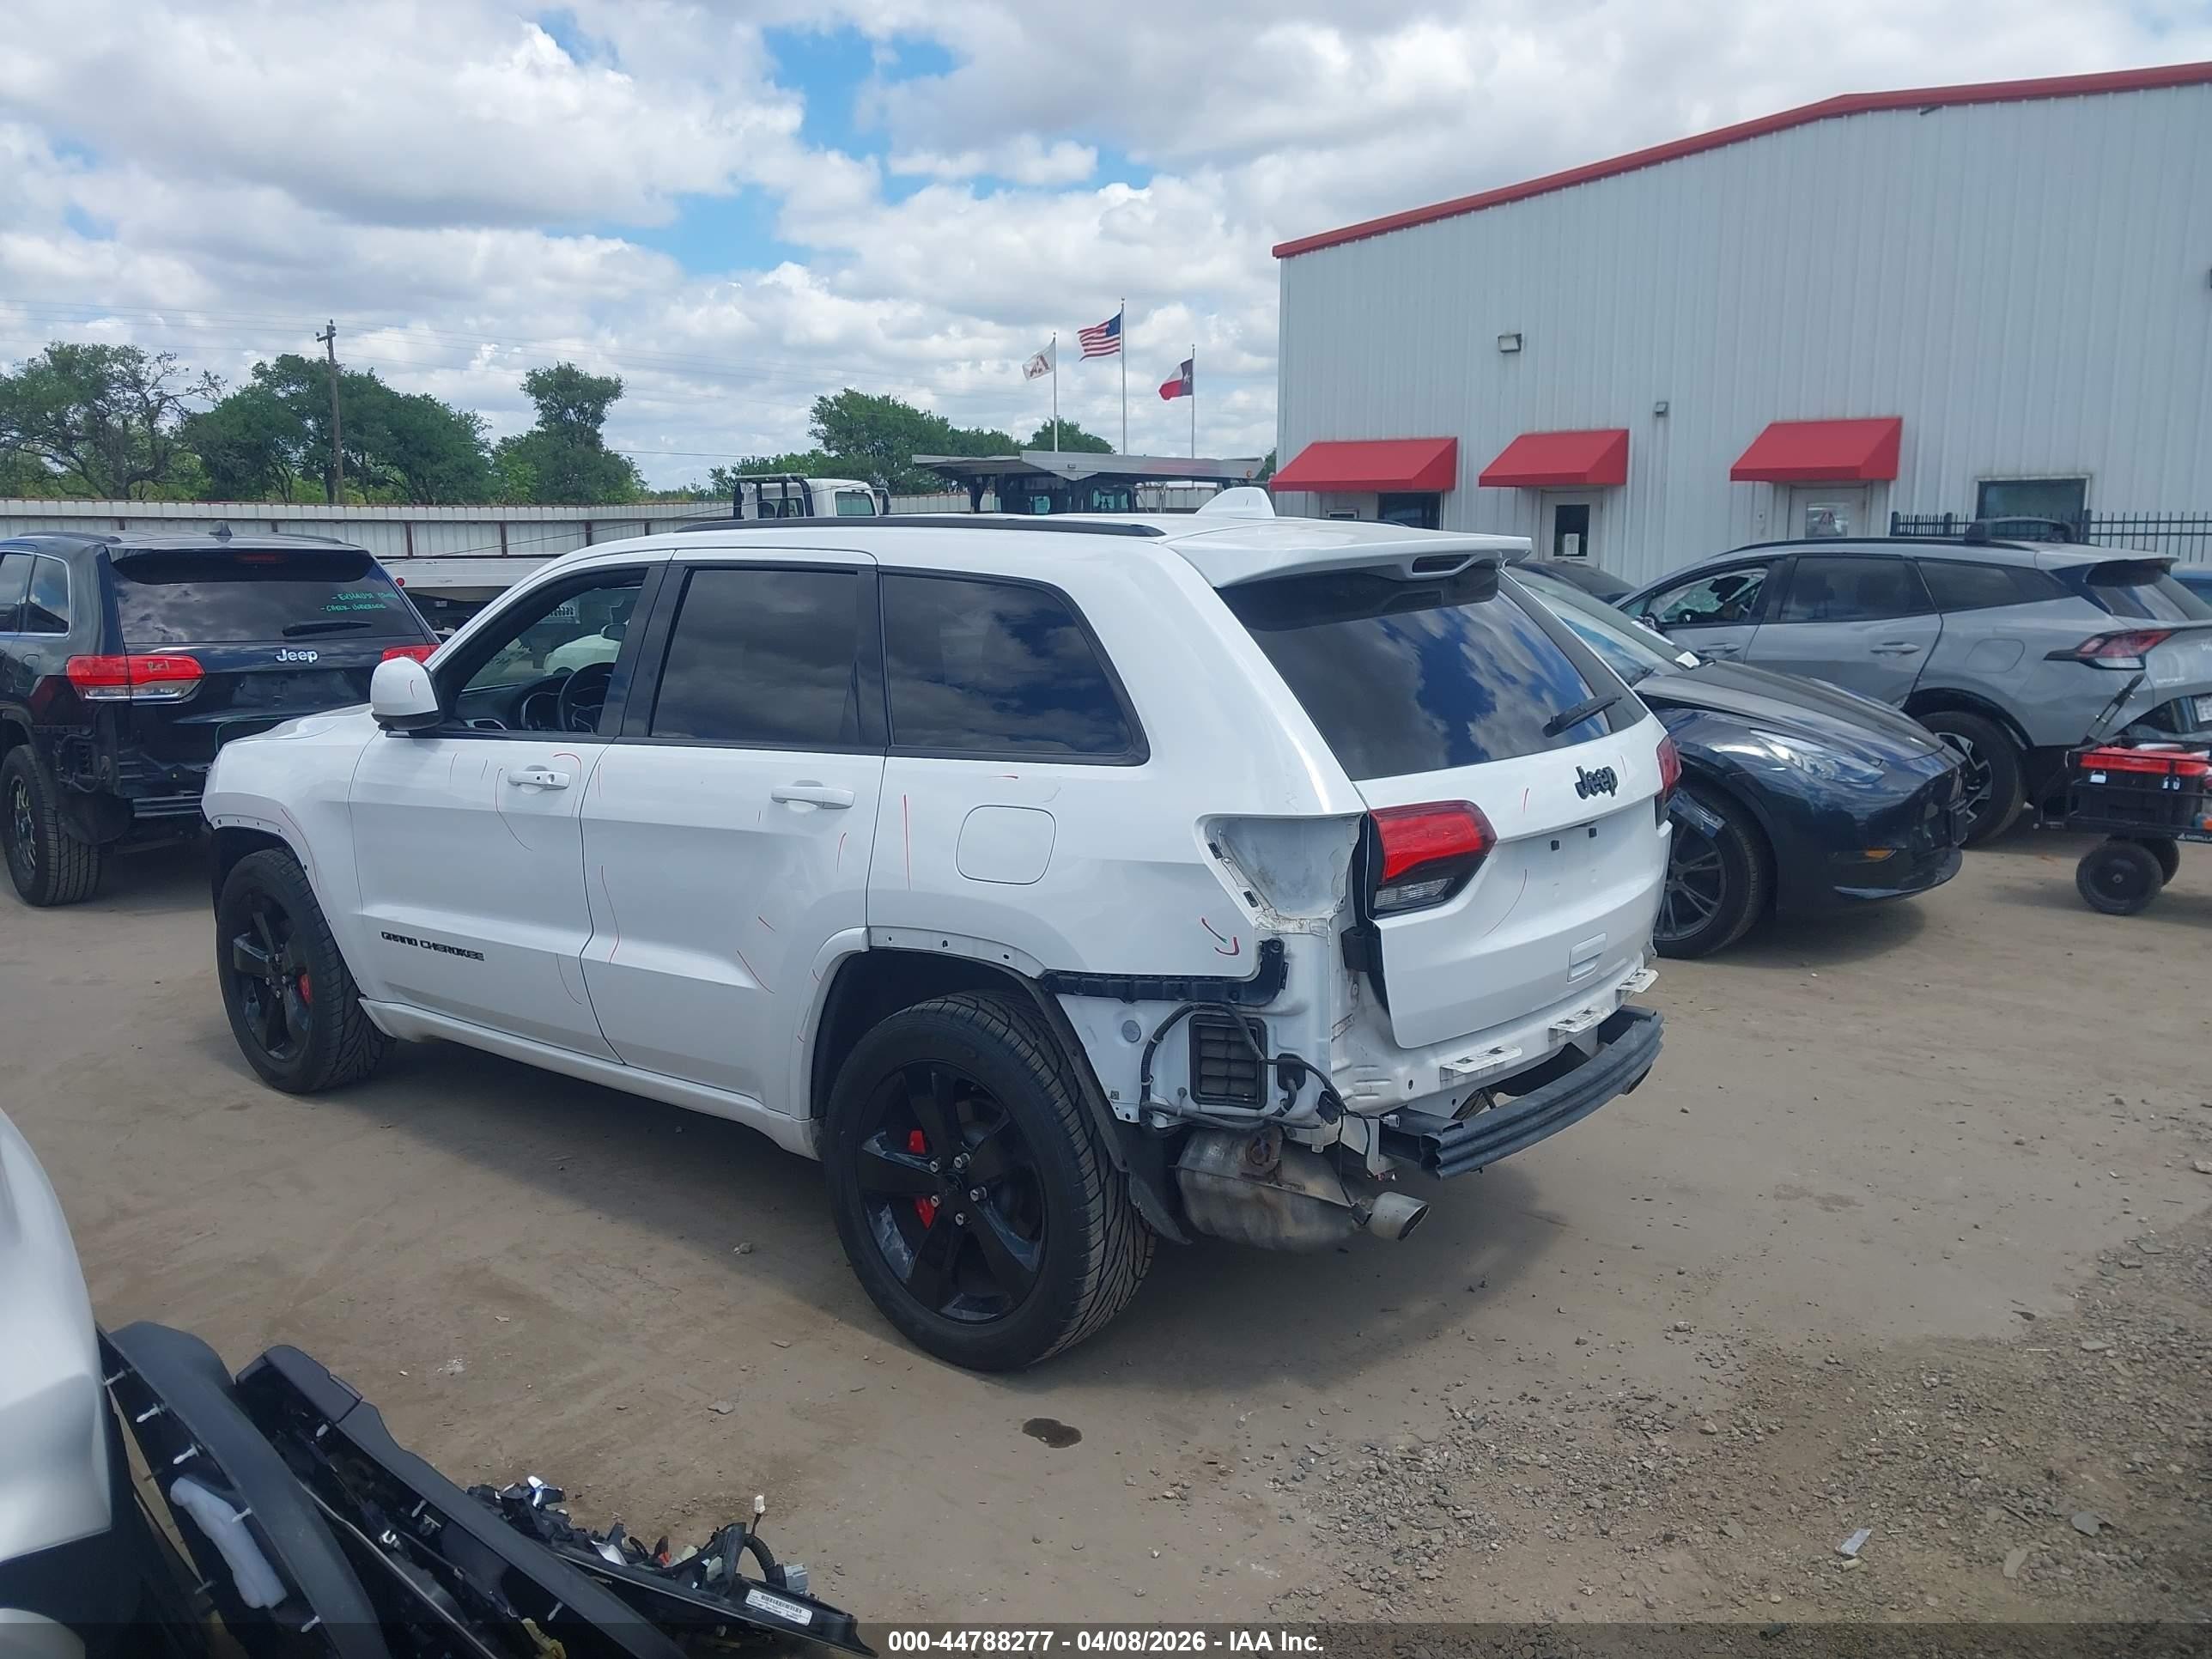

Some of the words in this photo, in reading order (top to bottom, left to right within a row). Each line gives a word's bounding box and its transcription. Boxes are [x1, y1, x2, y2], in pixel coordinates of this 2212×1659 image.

[276, 648, 318, 663] Jeep
[1575, 765, 1618, 799] Jeep
[381, 932, 418, 946] GRAND
[420, 940, 484, 961] CHEROKEE
